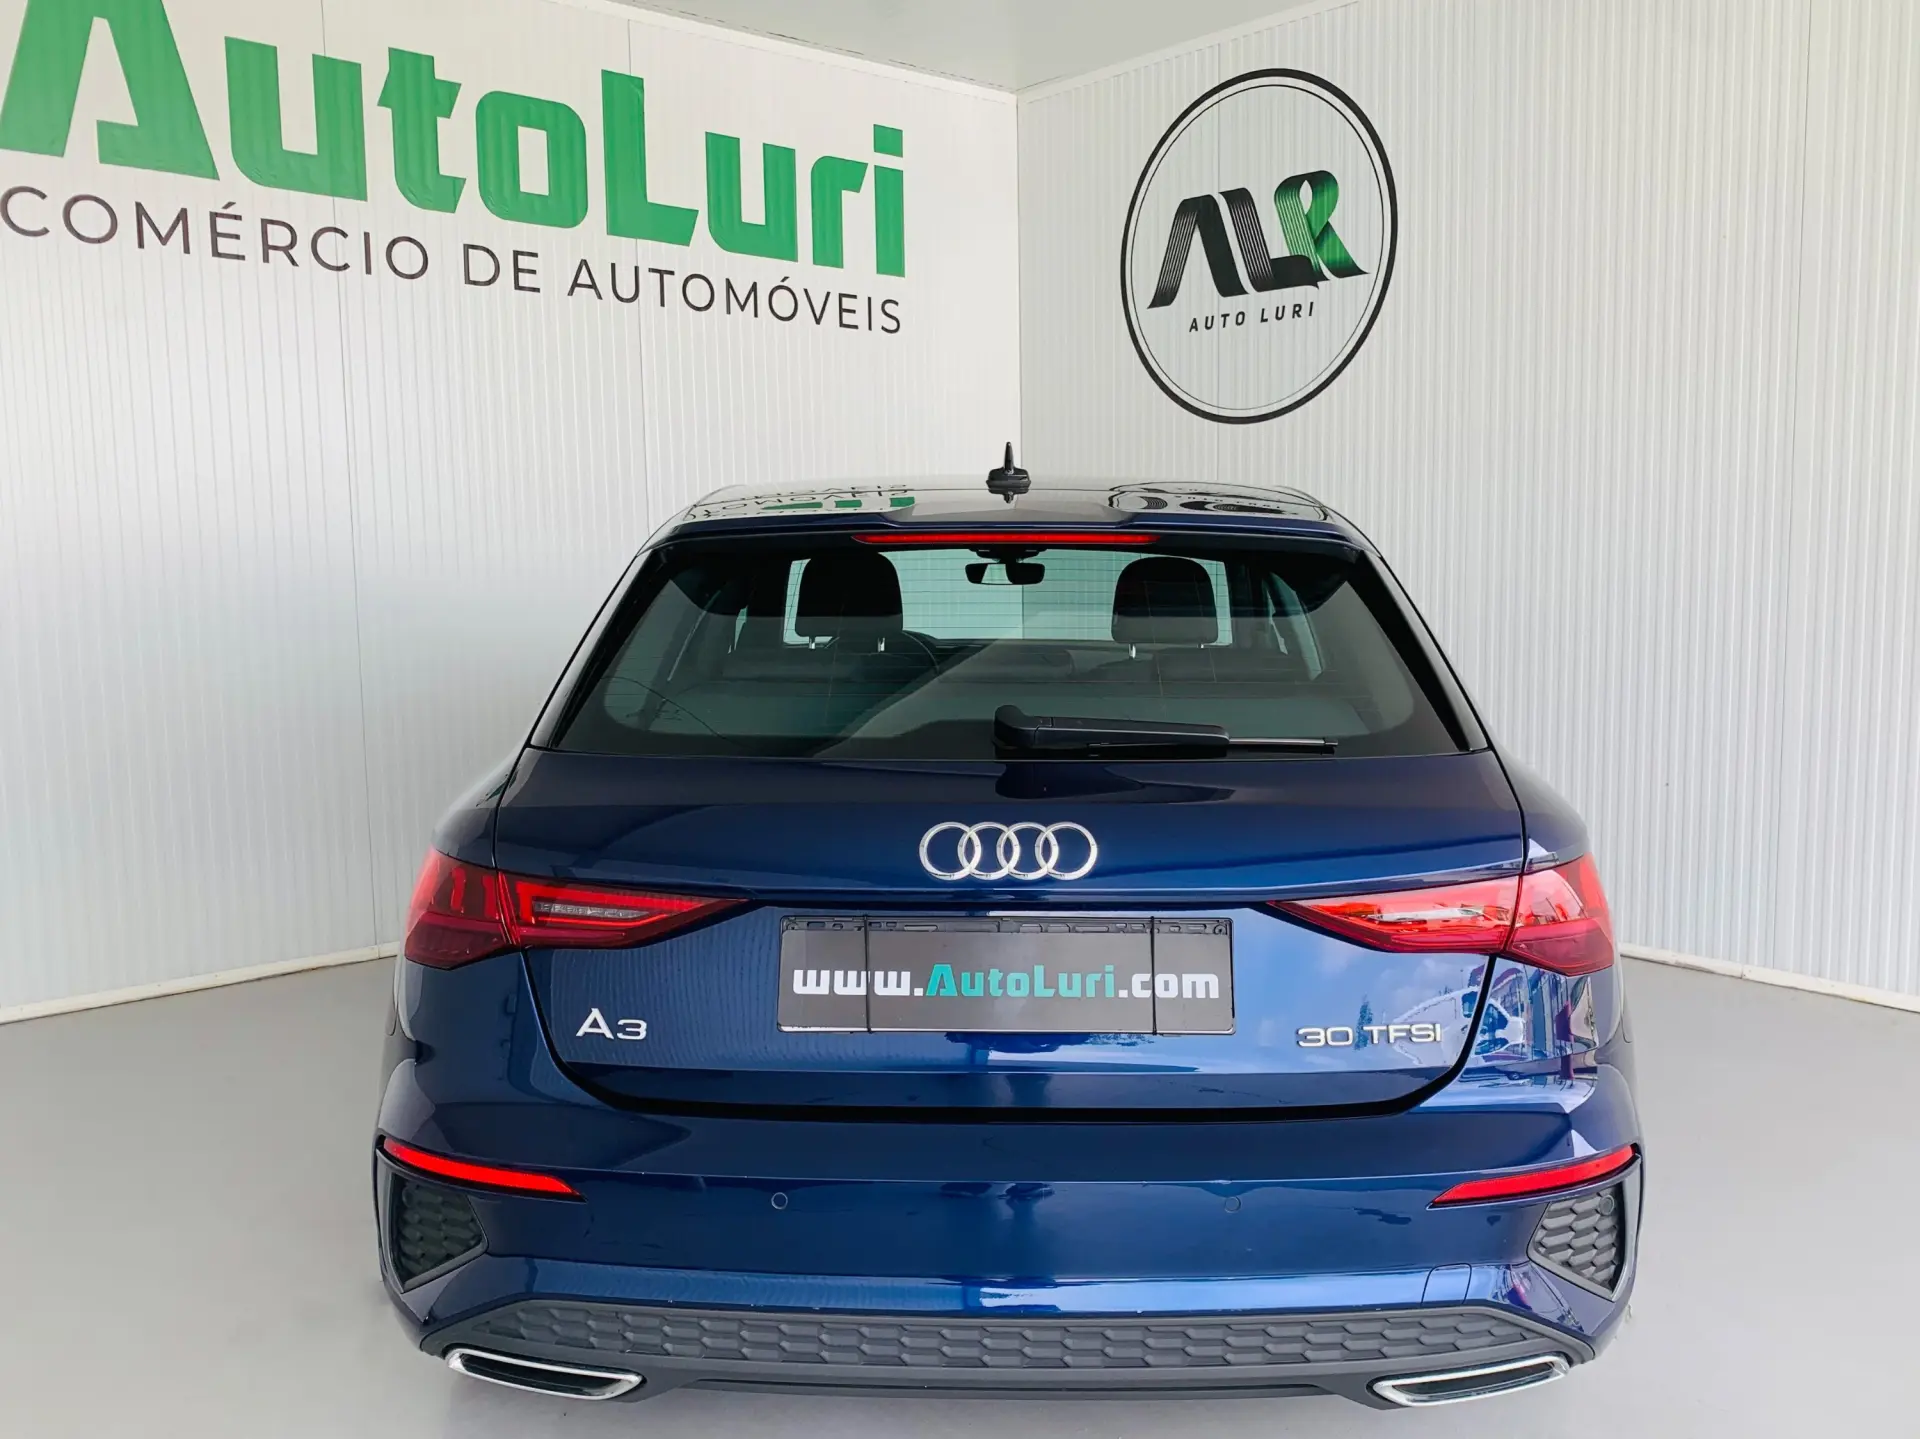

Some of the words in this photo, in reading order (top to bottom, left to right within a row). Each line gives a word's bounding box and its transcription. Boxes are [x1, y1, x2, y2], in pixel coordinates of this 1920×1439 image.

[0, 0, 906, 278] AutoLuri
[1, 185, 430, 280] COMÉRCIO
[462, 243, 541, 294] DE
[567, 257, 902, 335] AUTOMÓVEIS
[1189, 311, 1246, 333] AUTO
[1260, 301, 1315, 324] LURI
[793, 963, 1219, 999] www.AutoLuri.com
[576, 1007, 647, 1040] A3
[1297, 1026, 1353, 1047] 30
[1362, 1023, 1442, 1045] TFSI
